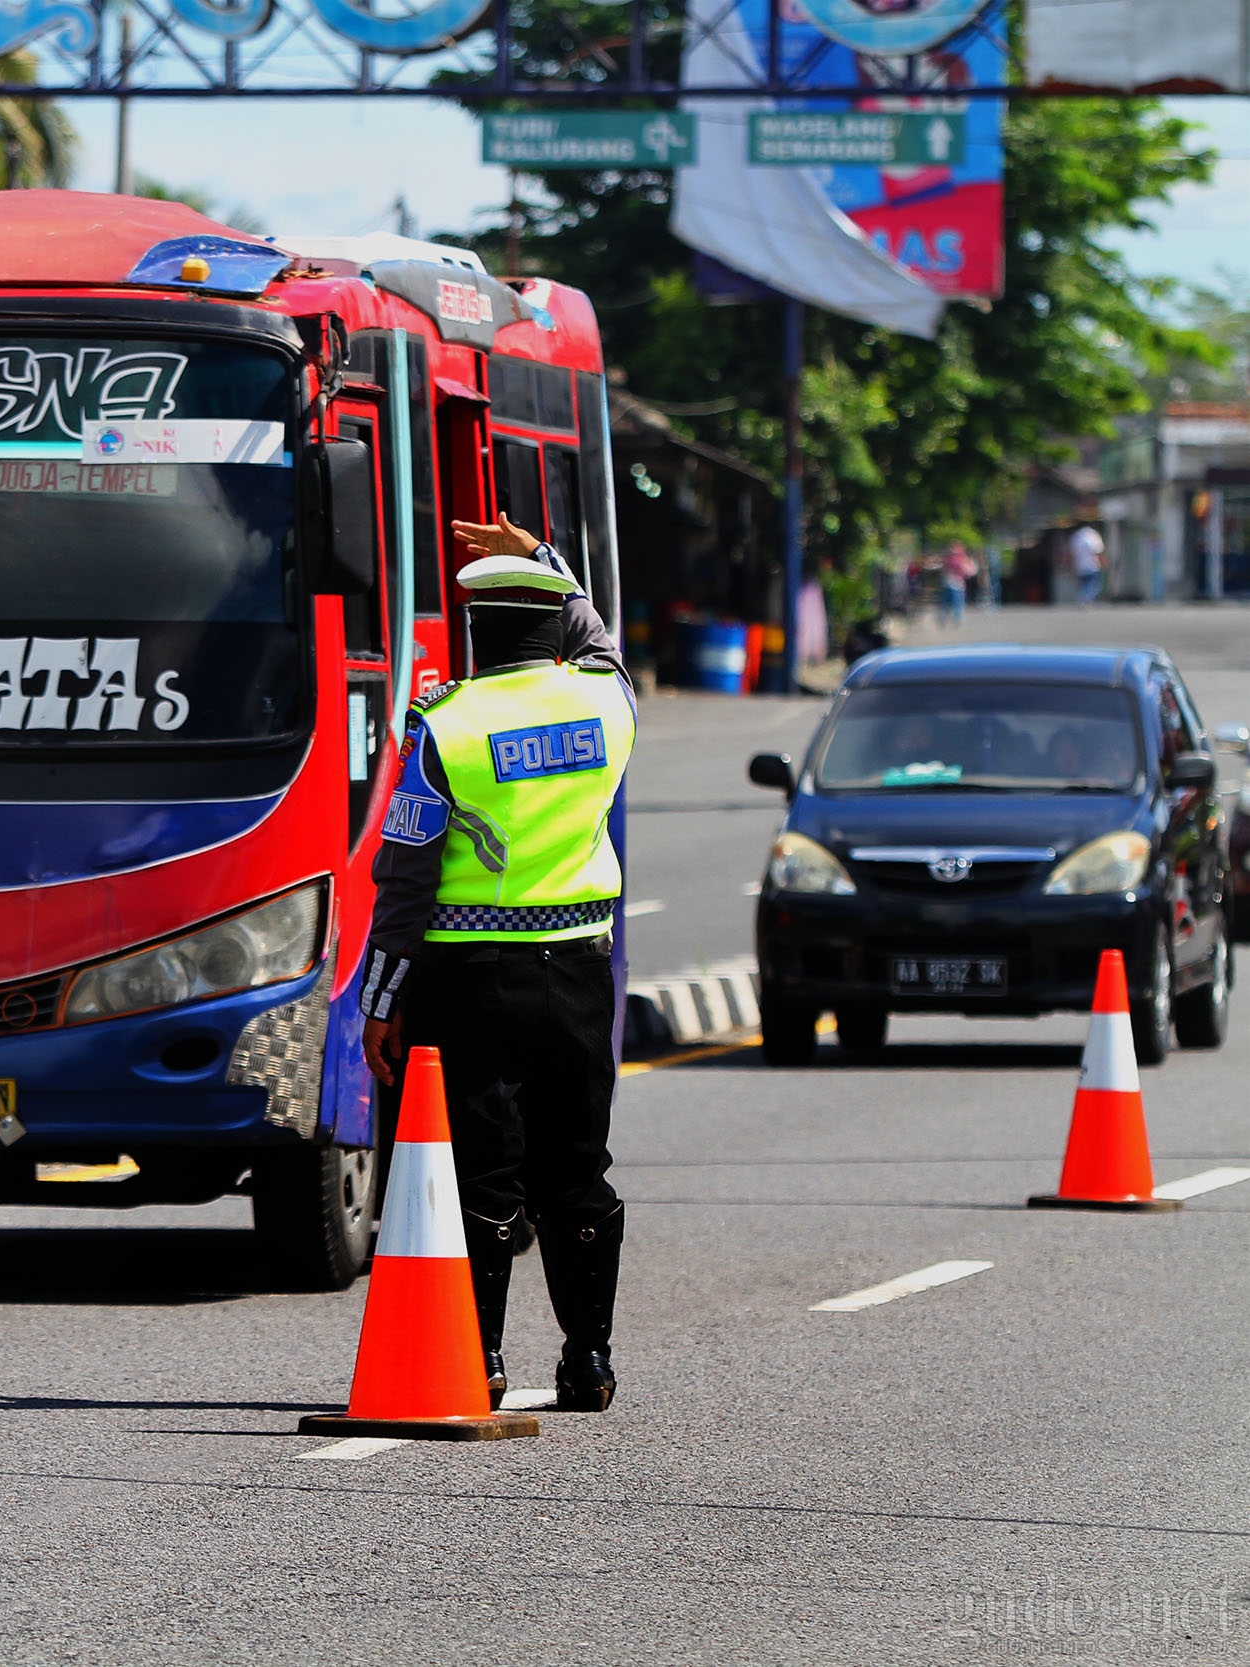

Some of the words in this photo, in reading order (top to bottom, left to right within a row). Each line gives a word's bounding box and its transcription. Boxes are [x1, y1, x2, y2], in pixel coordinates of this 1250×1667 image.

[492, 139, 635, 161] KALIURANG
[760, 140, 896, 160] SEMARANG
[497, 726, 605, 775] POLISI
